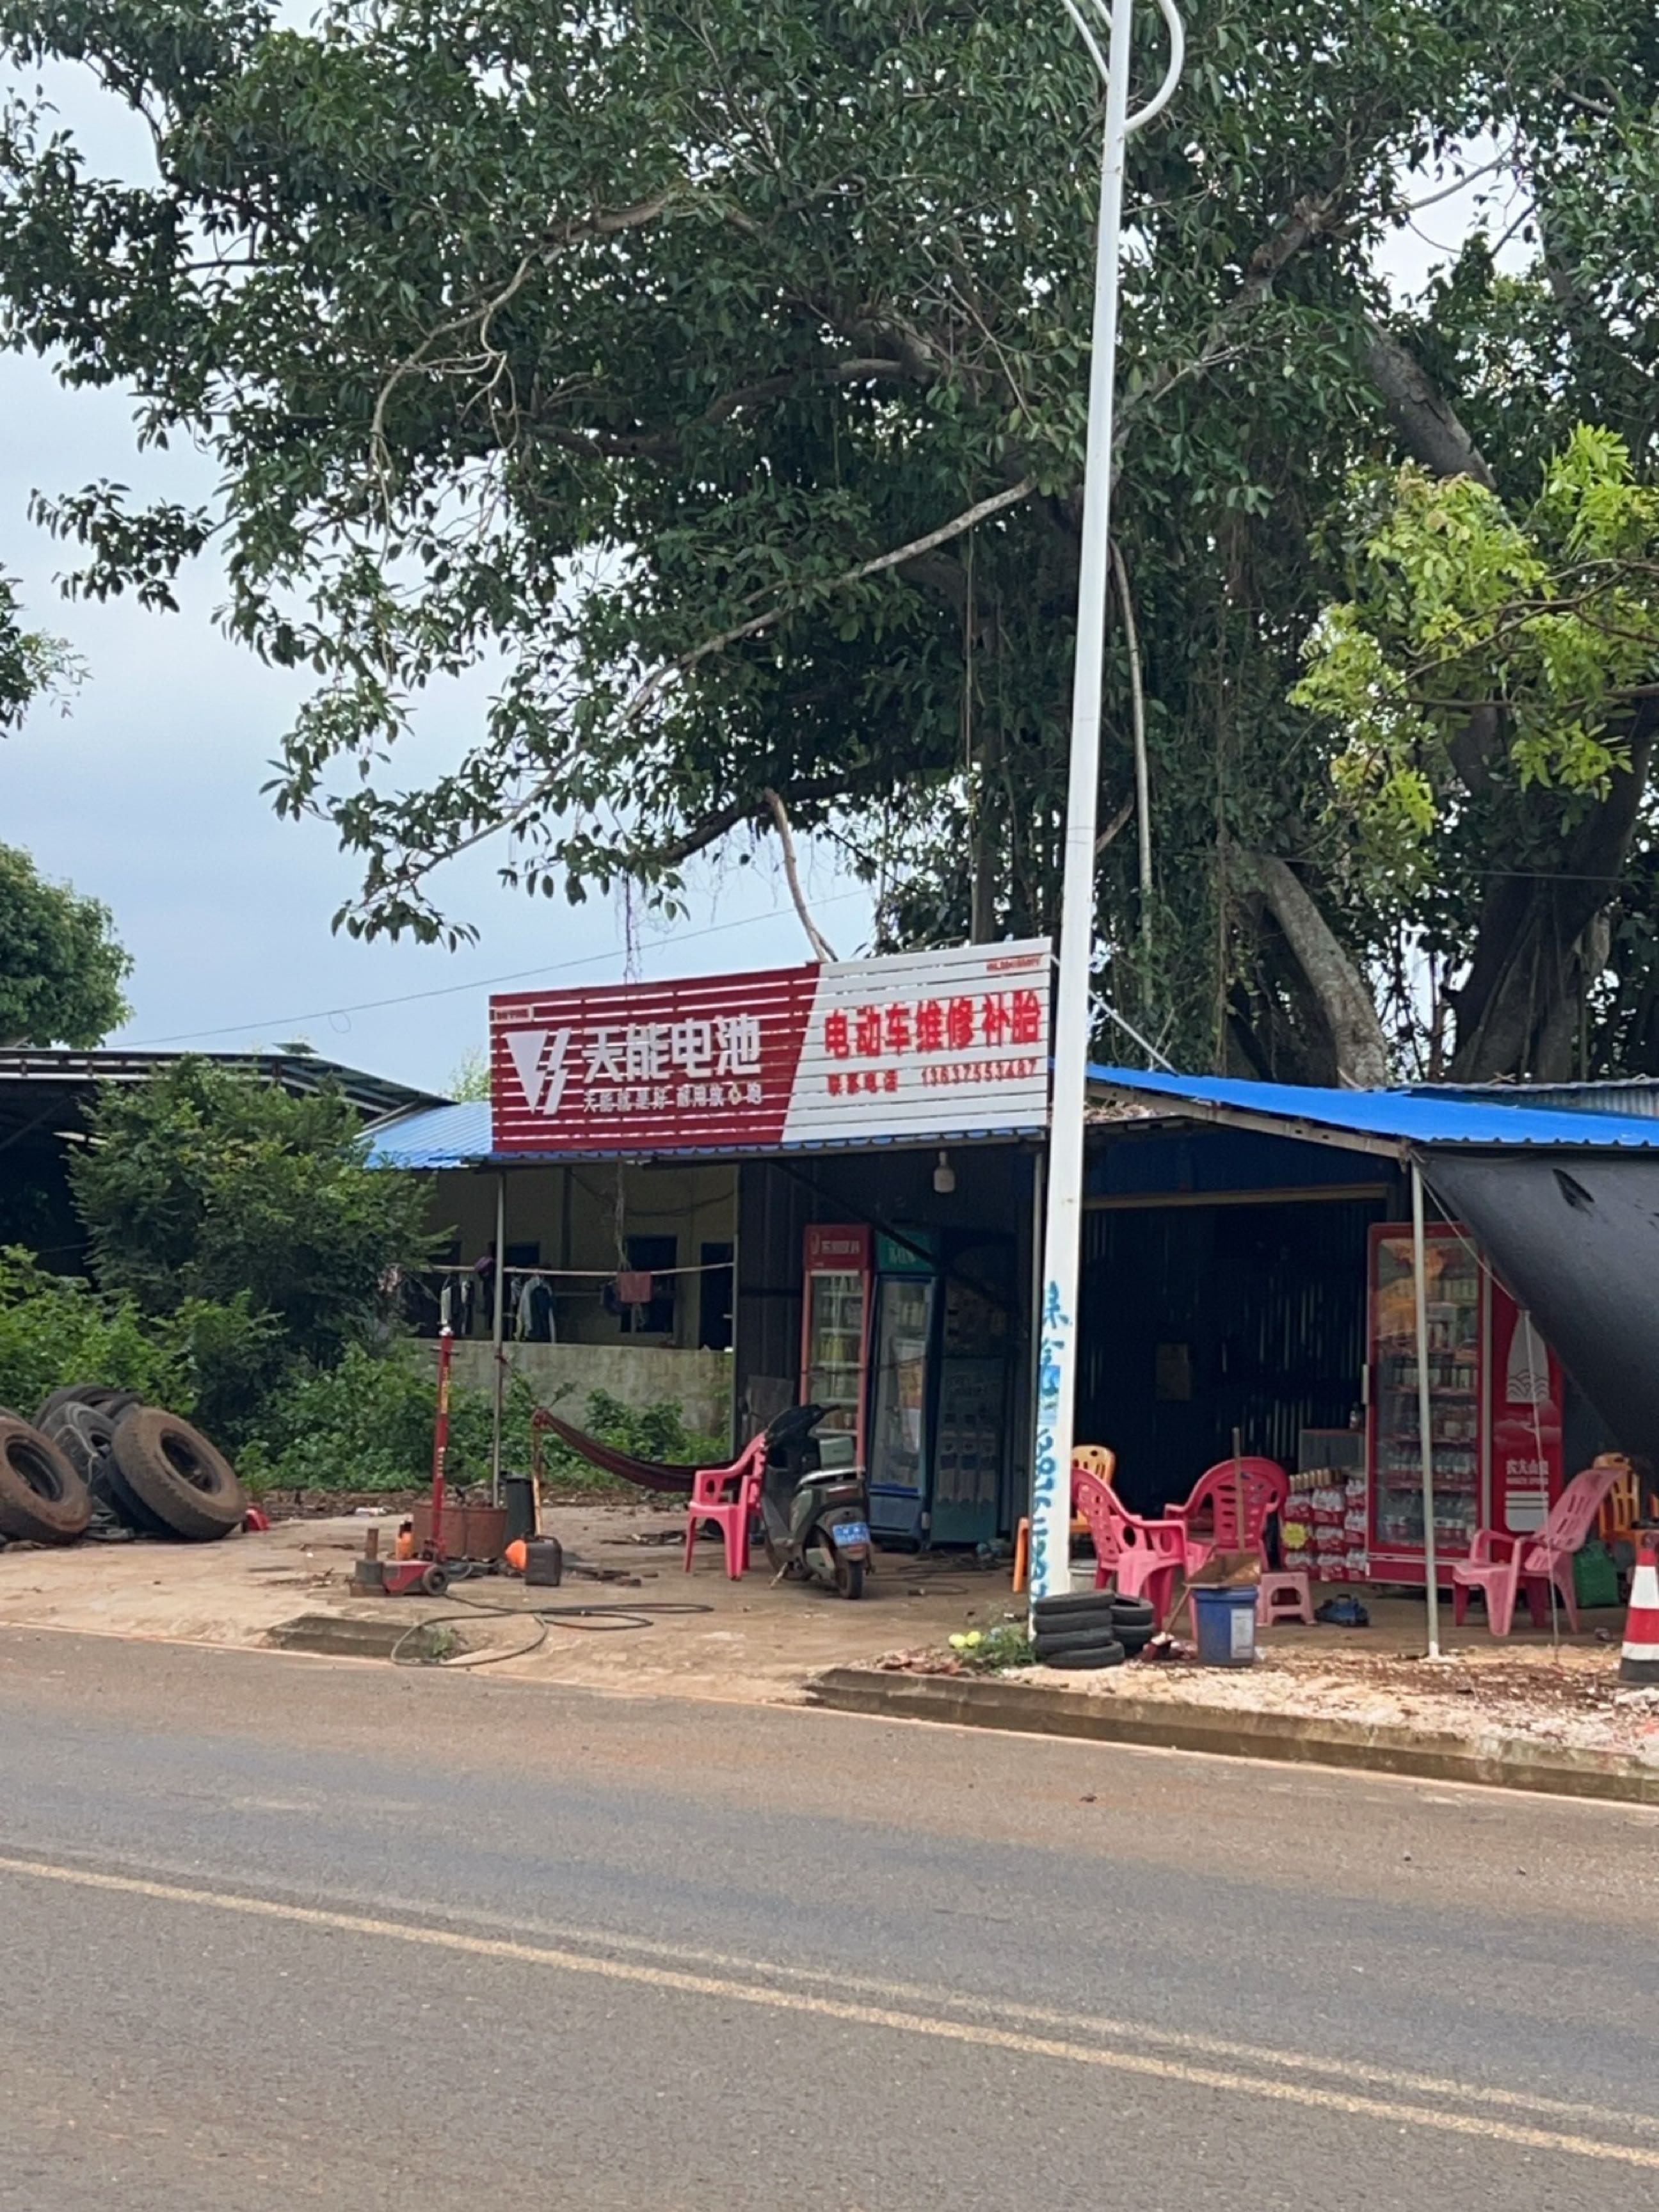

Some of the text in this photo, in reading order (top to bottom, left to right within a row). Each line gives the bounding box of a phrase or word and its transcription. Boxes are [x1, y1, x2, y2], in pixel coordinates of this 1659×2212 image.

[581, 1013, 761, 1084] 天能电池
[824, 990, 1039, 1059] 电动车维修 补胎
